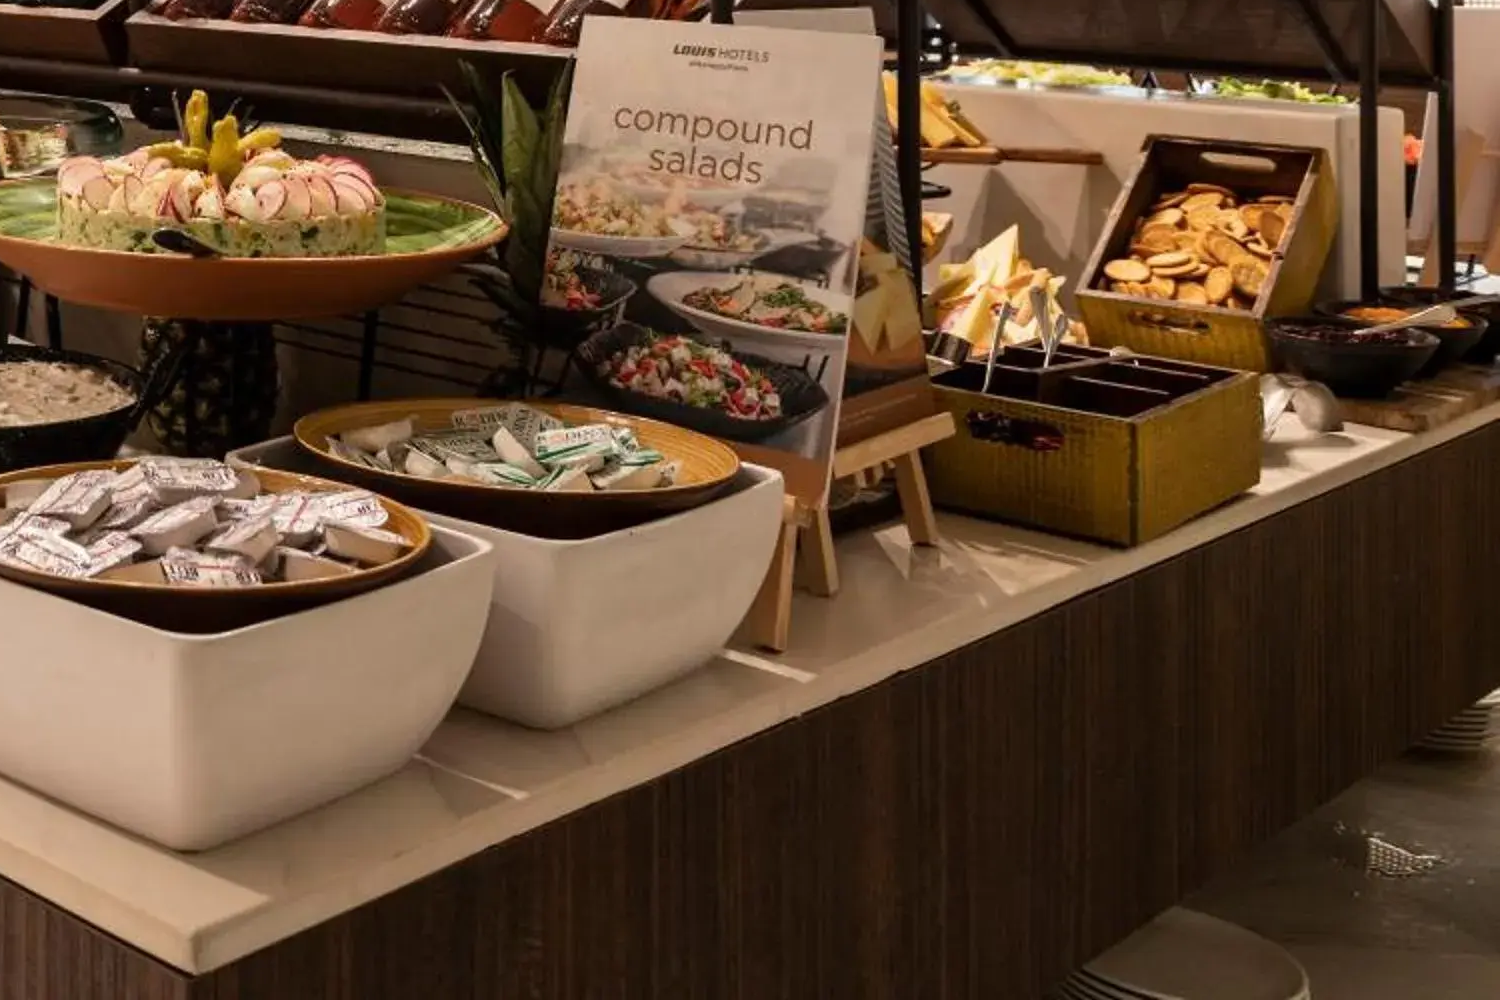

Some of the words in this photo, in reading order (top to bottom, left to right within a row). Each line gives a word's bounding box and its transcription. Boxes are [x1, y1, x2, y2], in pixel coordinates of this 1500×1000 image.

[673, 44, 717, 58] LOUIS
[719, 47, 770, 63] HOTELS
[614, 107, 813, 150] compound
[648, 146, 764, 184] salads
